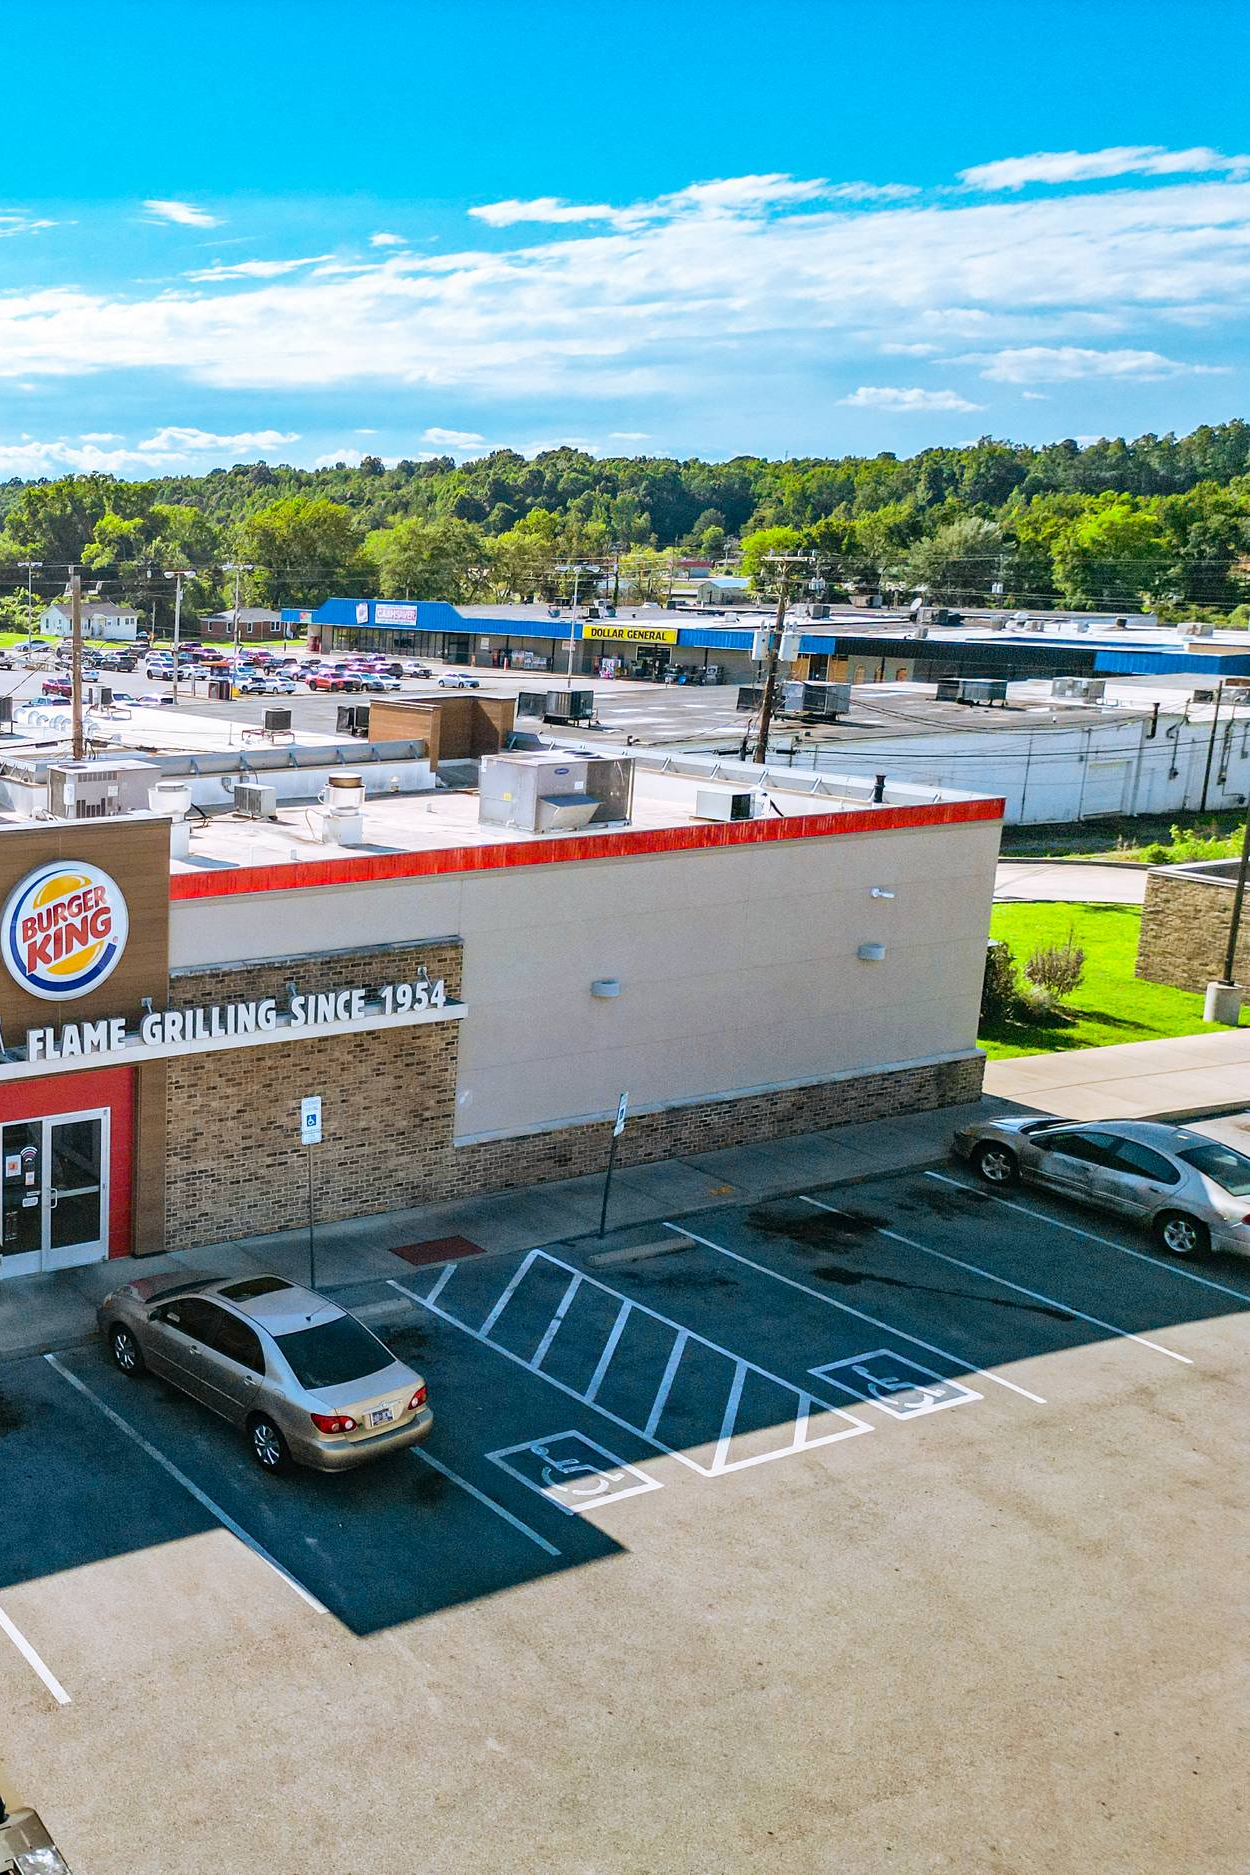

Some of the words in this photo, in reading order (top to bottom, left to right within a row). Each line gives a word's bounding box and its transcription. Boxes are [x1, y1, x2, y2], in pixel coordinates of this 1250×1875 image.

[591, 628, 624, 638] DOLLAR
[627, 630, 666, 640] GENERAL
[22, 885, 108, 943] BURGER
[27, 906, 111, 974] KING
[27, 1017, 126, 1063] FLAME
[141, 998, 277, 1046] GRILLING
[289, 988, 366, 1028] SINCE
[379, 979, 447, 1016] 1954
